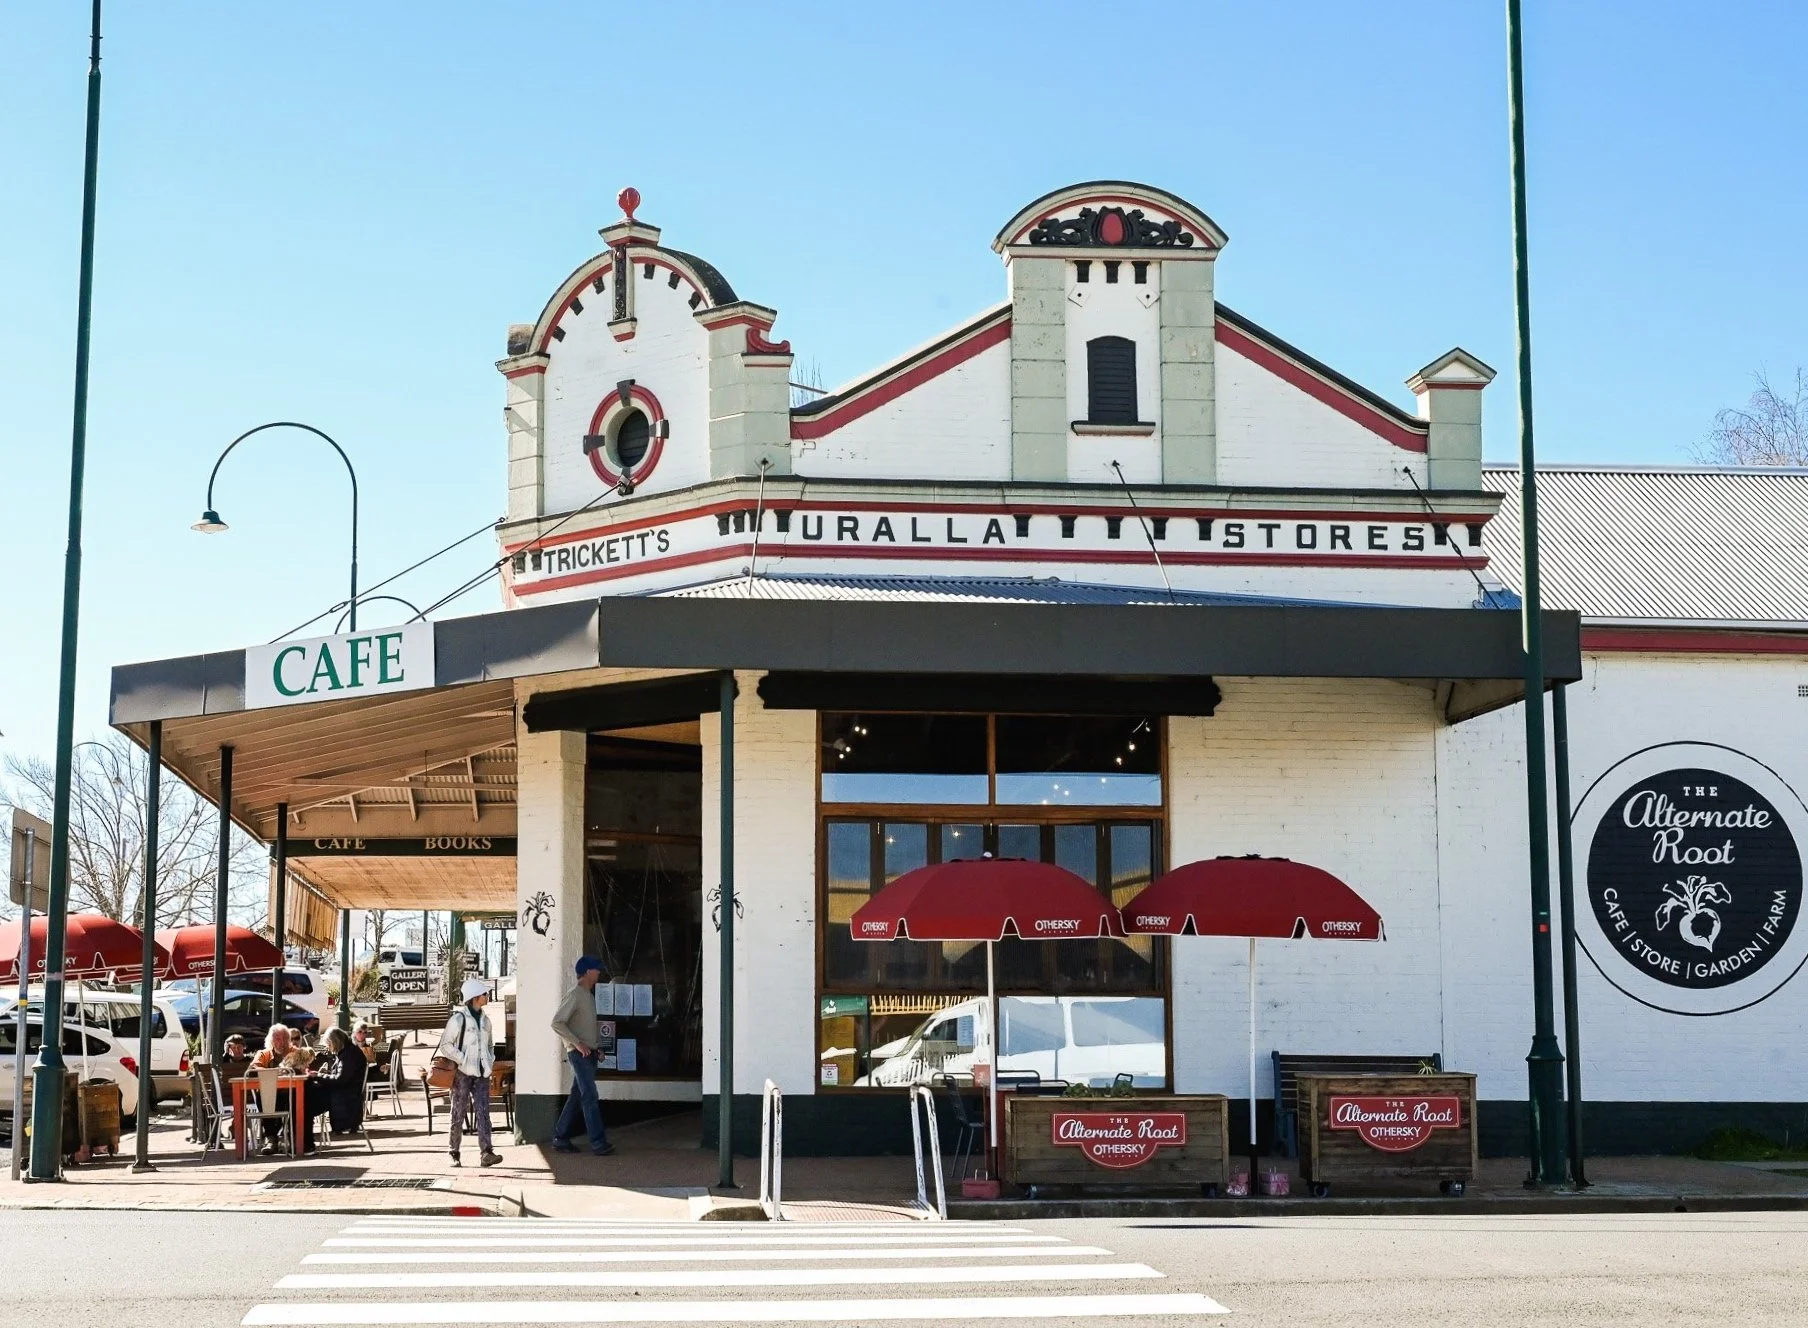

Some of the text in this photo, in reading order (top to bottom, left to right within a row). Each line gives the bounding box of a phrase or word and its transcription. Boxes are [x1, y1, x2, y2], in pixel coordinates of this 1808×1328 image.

[801, 514, 1425, 552] URALLA STORES
[543, 528, 670, 574] TRICKETT'S
[272, 631, 405, 698] CAFE
[1683, 786, 1718, 797] THE
[1622, 790, 1773, 829] Alternate
[315, 836, 492, 850] CAFE BOOKS
[1652, 827, 1736, 865] Root
[1034, 919, 1081, 931] OTHERSKY
[1136, 915, 1171, 927] OTHERSKY
[1321, 921, 1362, 933] OTHERSKY
[1603, 887, 1787, 978] CAFE STORE GARDEN FARM
[391, 970, 427, 980] GALLERY
[393, 981, 426, 991] OPEN
[1336, 1101, 1453, 1122] Alternate Root
[1059, 1118, 1179, 1139] Alternate Root
[1369, 1126, 1422, 1138] OTHERSKY
[1093, 1143, 1146, 1155] OTHERSKY
